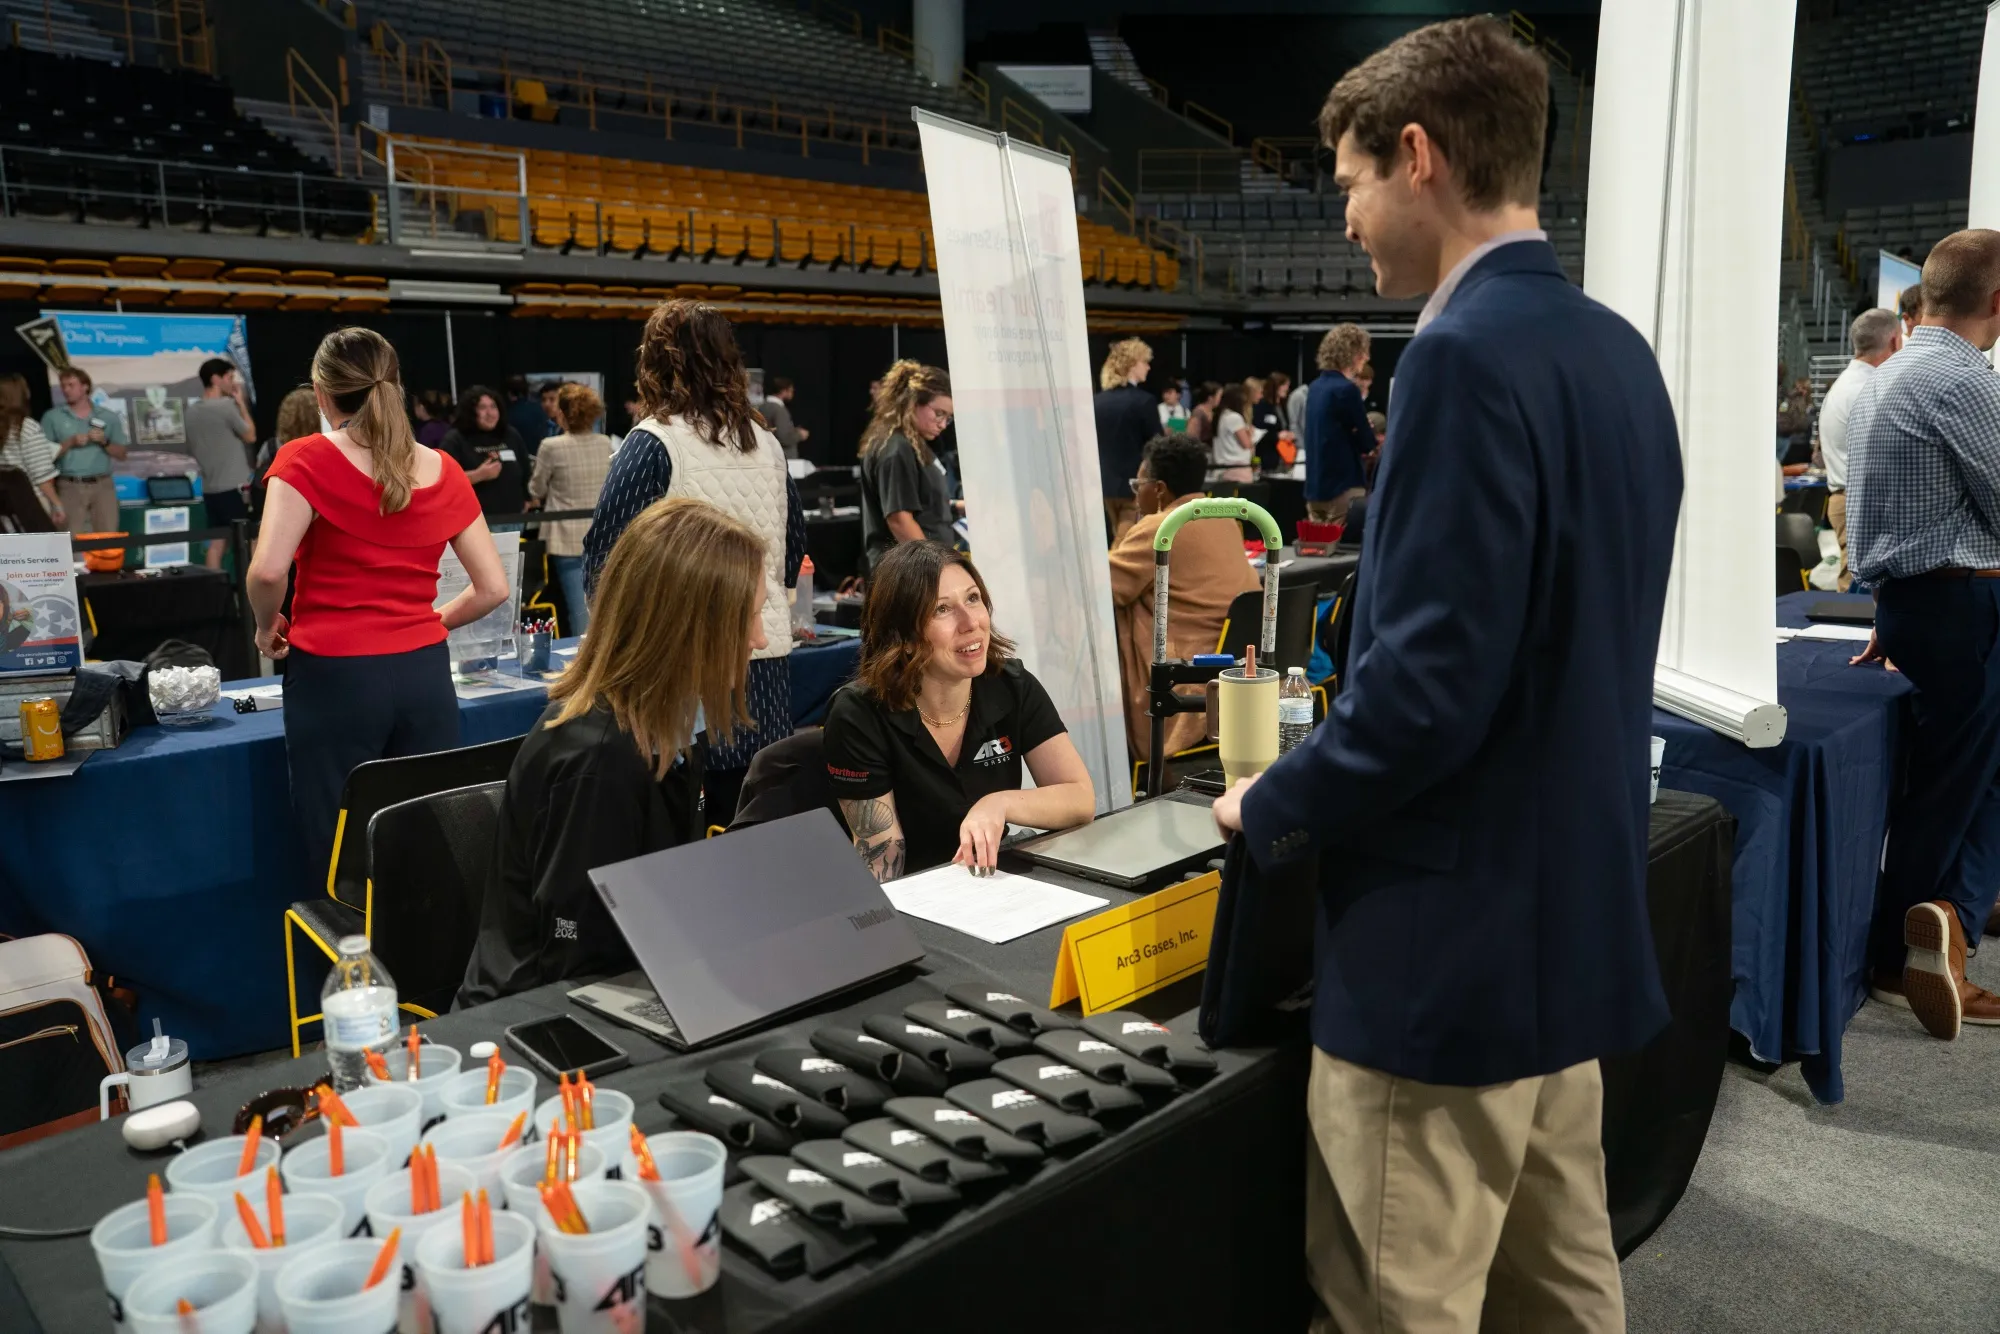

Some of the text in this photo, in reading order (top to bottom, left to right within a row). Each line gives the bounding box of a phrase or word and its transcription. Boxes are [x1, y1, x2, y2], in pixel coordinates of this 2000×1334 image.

[1203, 505, 1239, 514] COSCO
[27, 556, 59, 564] Services
[6, 571, 23, 580] Join
[1116, 929, 1198, 970] Arc3 Gases, Inc.
